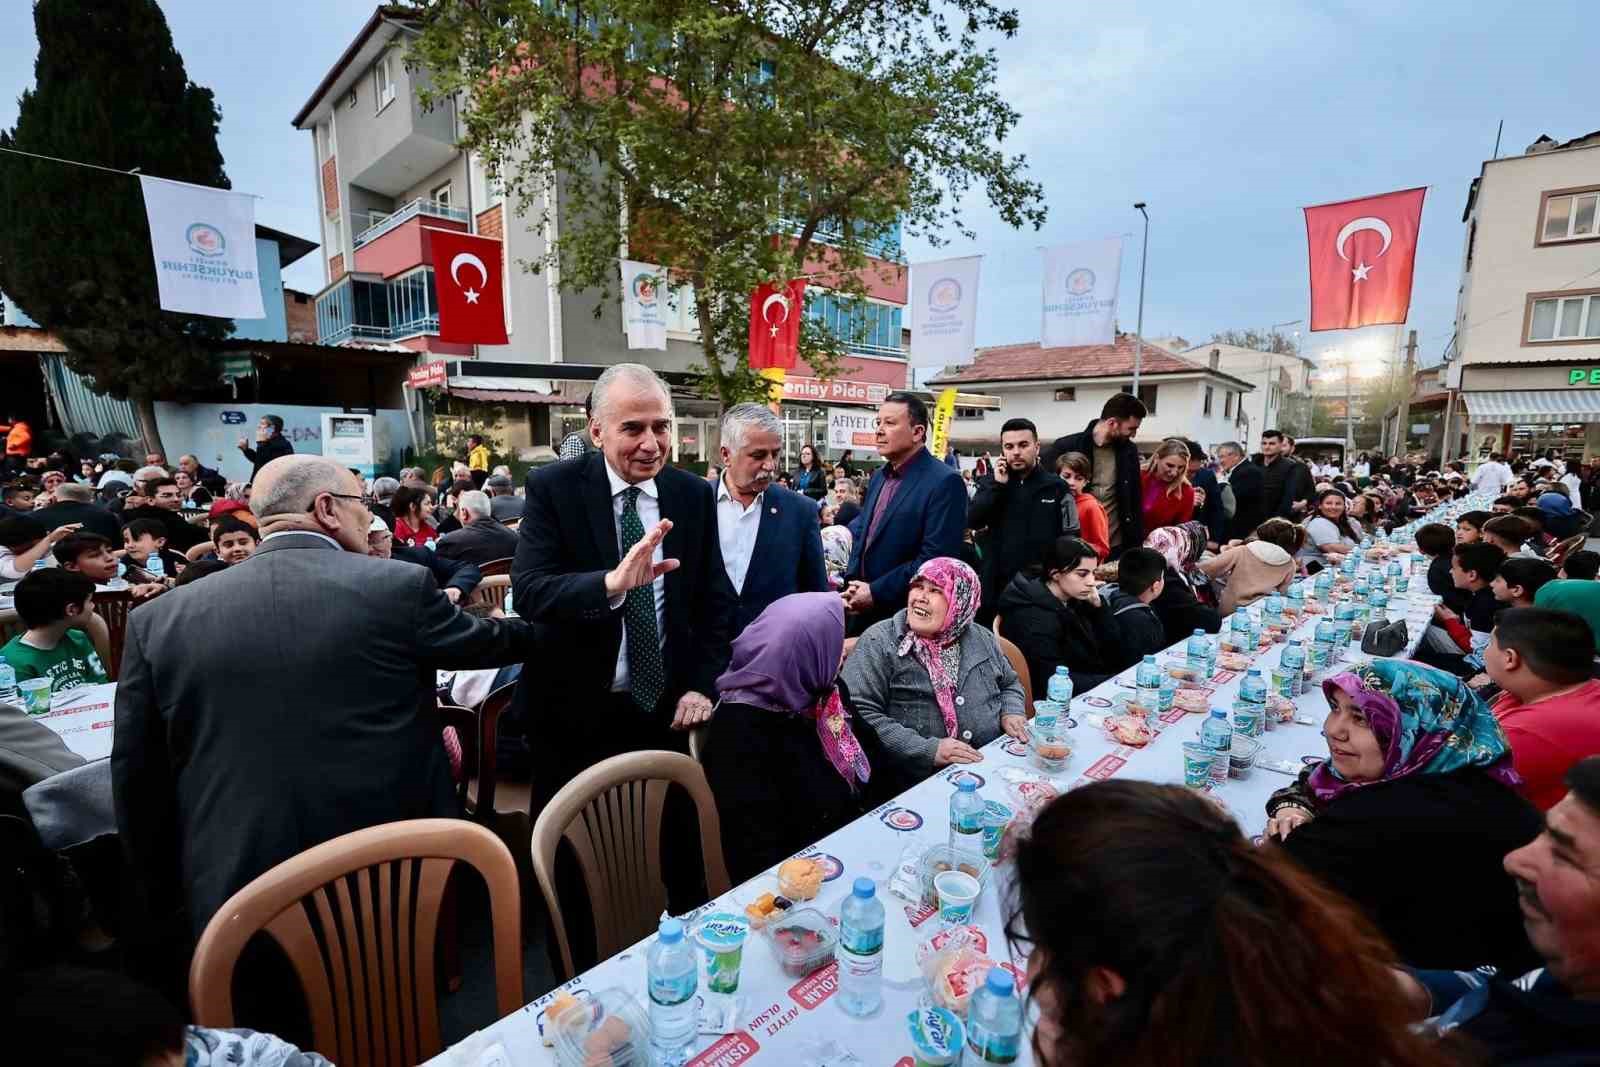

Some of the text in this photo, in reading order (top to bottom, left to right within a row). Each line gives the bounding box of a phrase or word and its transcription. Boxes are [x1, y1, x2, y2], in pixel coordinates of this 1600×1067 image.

[783, 381, 828, 398] eniay
[832, 383, 865, 398] Pide
[748, 1003, 781, 1032] OLSUN
